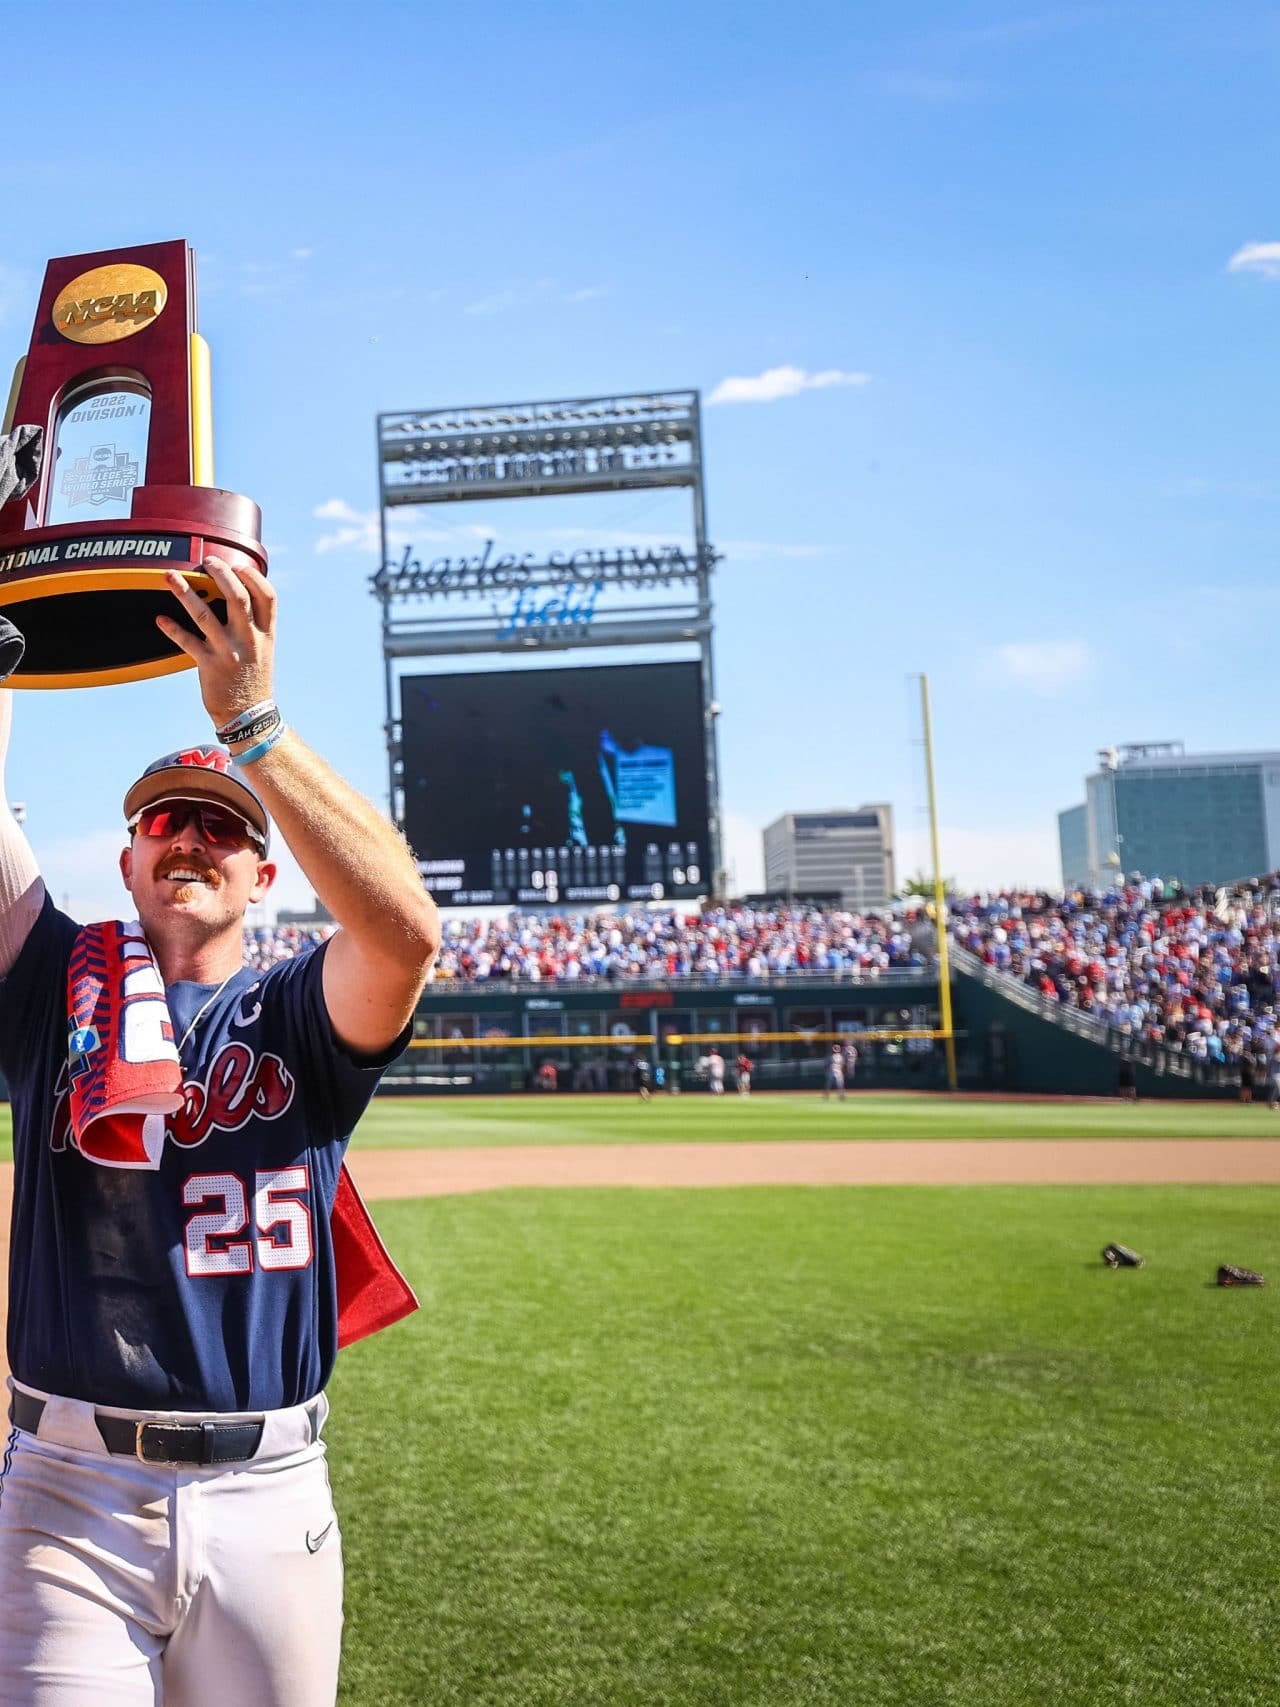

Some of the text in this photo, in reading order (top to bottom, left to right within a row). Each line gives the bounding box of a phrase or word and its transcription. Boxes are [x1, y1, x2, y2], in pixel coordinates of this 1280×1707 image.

[58, 290, 161, 331] NCAA
[90, 395, 127, 409] 2022
[70, 403, 146, 423] DIVISION I
[79, 470, 121, 481] COLLEGE
[99, 477, 136, 489] SERIES
[64, 539, 172, 559] CHAMPION
[181, 1164, 314, 1278] 25
